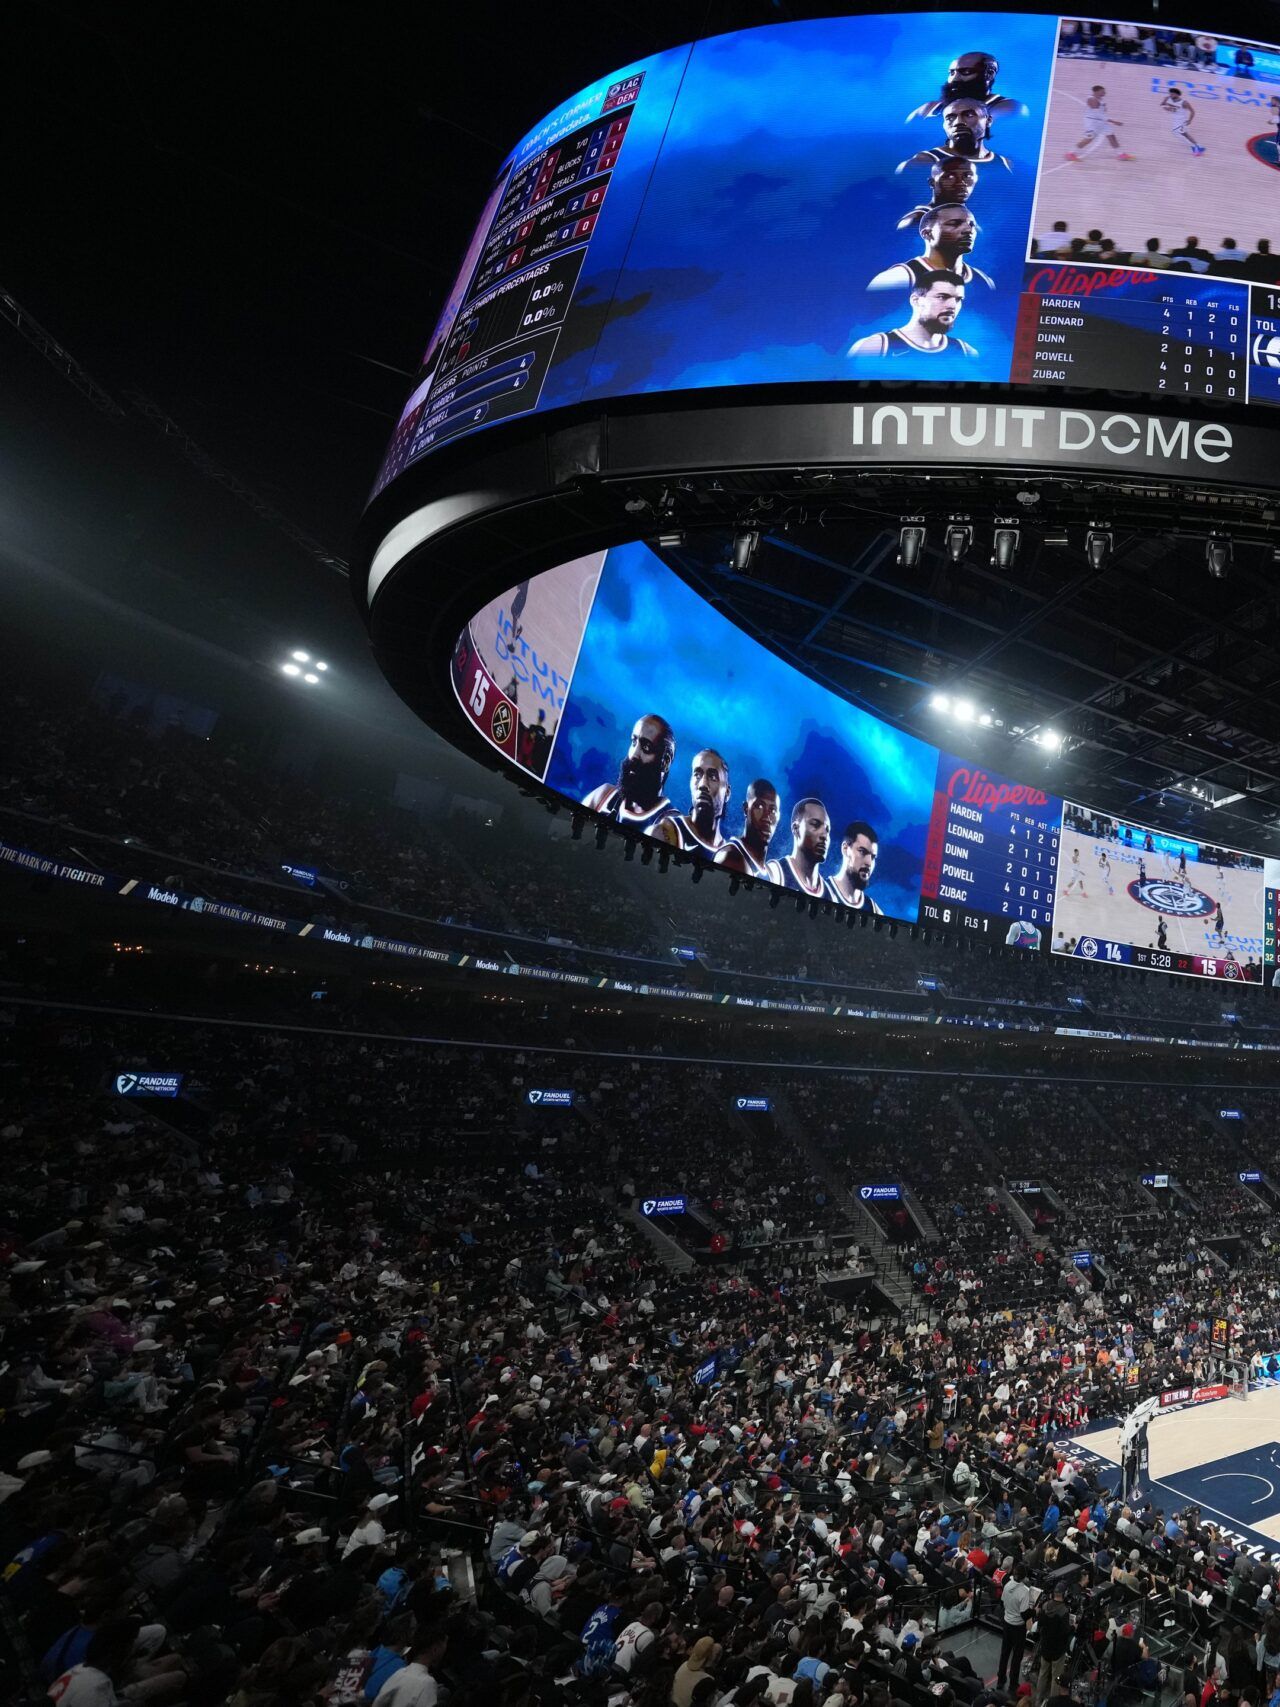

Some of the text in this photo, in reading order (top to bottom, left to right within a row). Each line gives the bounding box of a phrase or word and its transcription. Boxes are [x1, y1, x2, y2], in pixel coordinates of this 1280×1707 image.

[622, 78, 639, 91] LAC
[617, 92, 634, 104] DEN
[557, 156, 581, 173] BLOCKS
[552, 173, 574, 191] STEALS
[496, 263, 550, 294] PERCENTAGES
[1042, 299, 1237, 326] HARDEN 4 1 2 0
[1040, 316, 1084, 327] LEONARD
[1256, 320, 1276, 331] TOL
[1038, 334, 1065, 343] DUNN
[1036, 352, 1074, 362] POWELL
[462, 358, 488, 377] POINTS
[1033, 369, 1065, 380] ZUBAC
[853, 405, 1045, 447] INTUIT
[469, 670, 490, 716] 15
[948, 768, 1048, 812] Clippers
[951, 803, 982, 823] HARDEN
[948, 823, 983, 843] LEONARD
[945, 843, 968, 859] DUNN
[0, 847, 104, 886] THE MARK OF A FIGHTER
[943, 864, 974, 883] POWELL
[148, 887, 178, 905] Modelo
[940, 885, 967, 901] ZUBAC
[203, 902, 218, 914] THE
[220, 906, 241, 919] MARK
[242, 912, 251, 920] OF
[257, 916, 286, 929] FIGHTER
[924, 906, 950, 922] TOL 6
[965, 917, 988, 932] FLS 1
[1266, 923, 1274, 931] 15
[324, 930, 350, 943] Modelo
[1266, 938, 1274, 946] 27
[1105, 943, 1121, 961] 14
[1150, 953, 1171, 967] 5:28
[1265, 953, 1274, 962] 32
[1201, 960, 1217, 976] 15
[139, 1077, 178, 1086] FANDUEL
